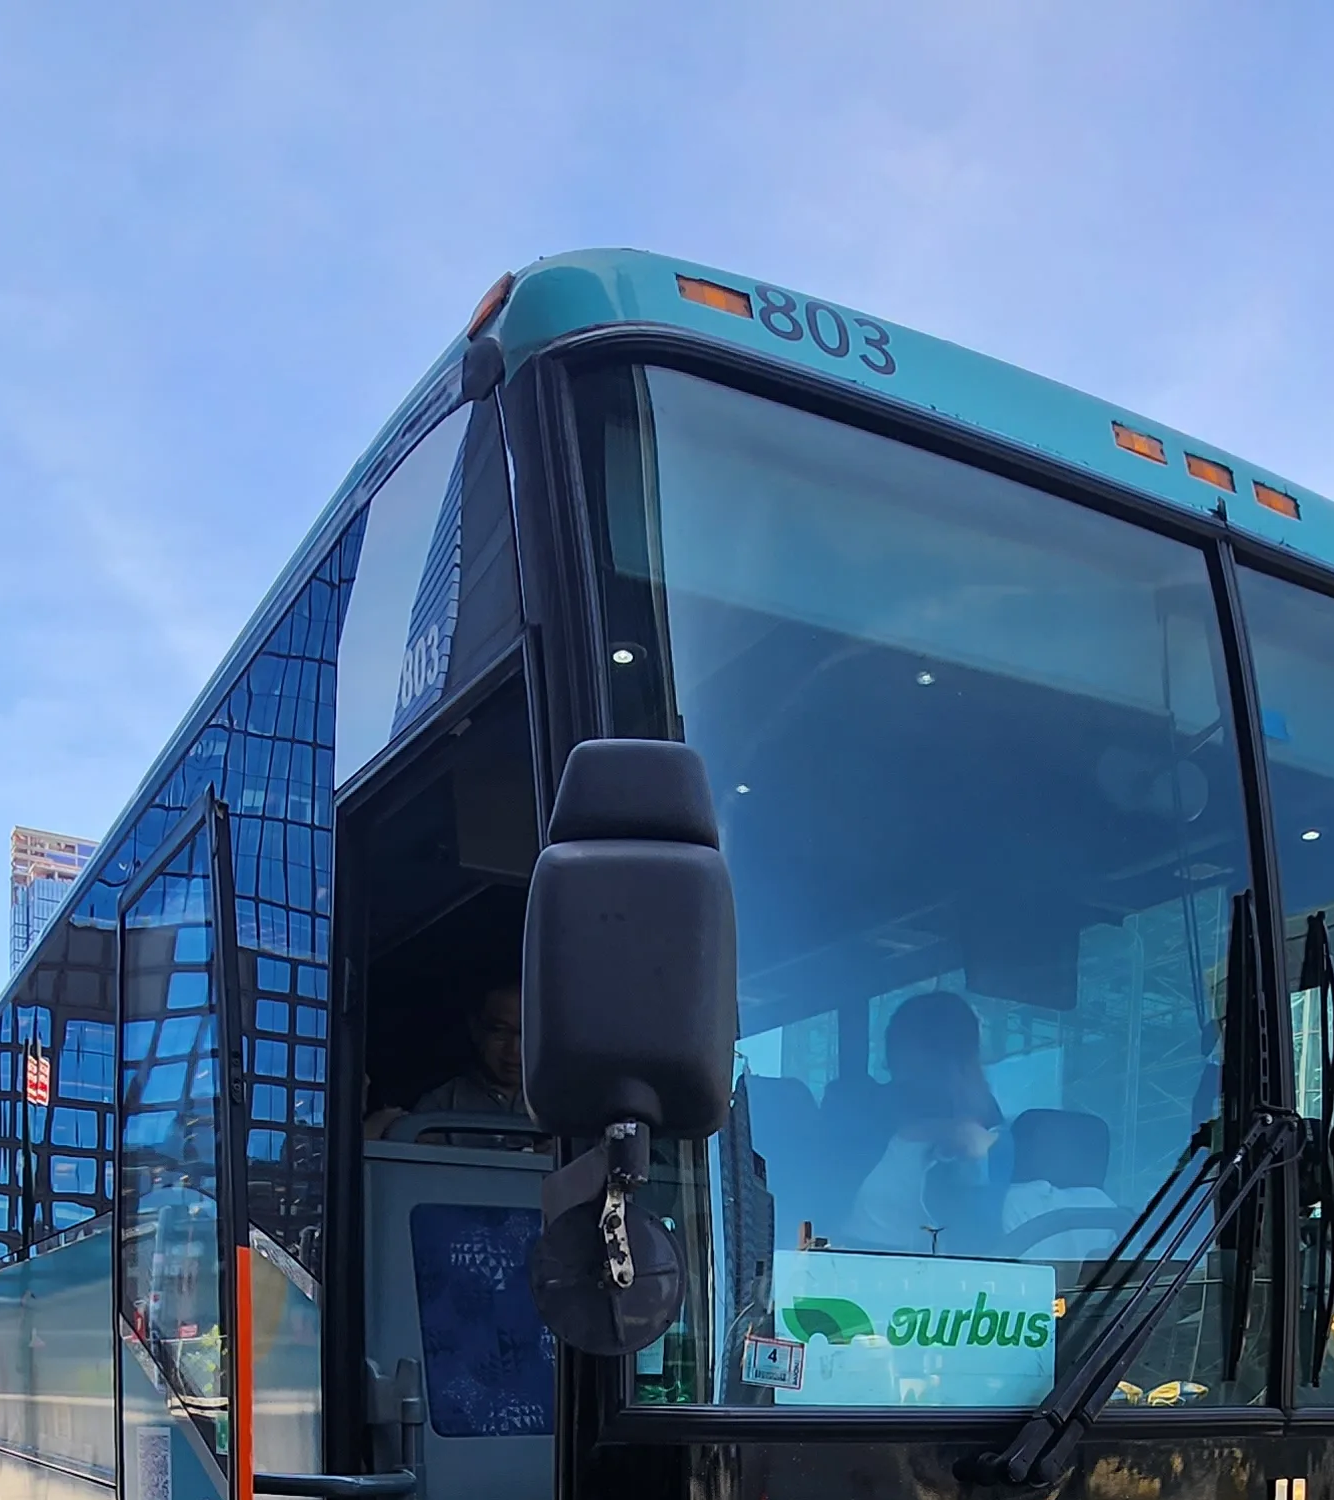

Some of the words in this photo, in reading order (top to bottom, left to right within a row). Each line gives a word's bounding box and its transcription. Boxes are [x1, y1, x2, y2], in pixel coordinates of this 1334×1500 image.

[753, 284, 897, 376] 803
[401, 623, 439, 709] 803
[767, 1348, 778, 1363] 4
[886, 1291, 1052, 1349] ourbus
